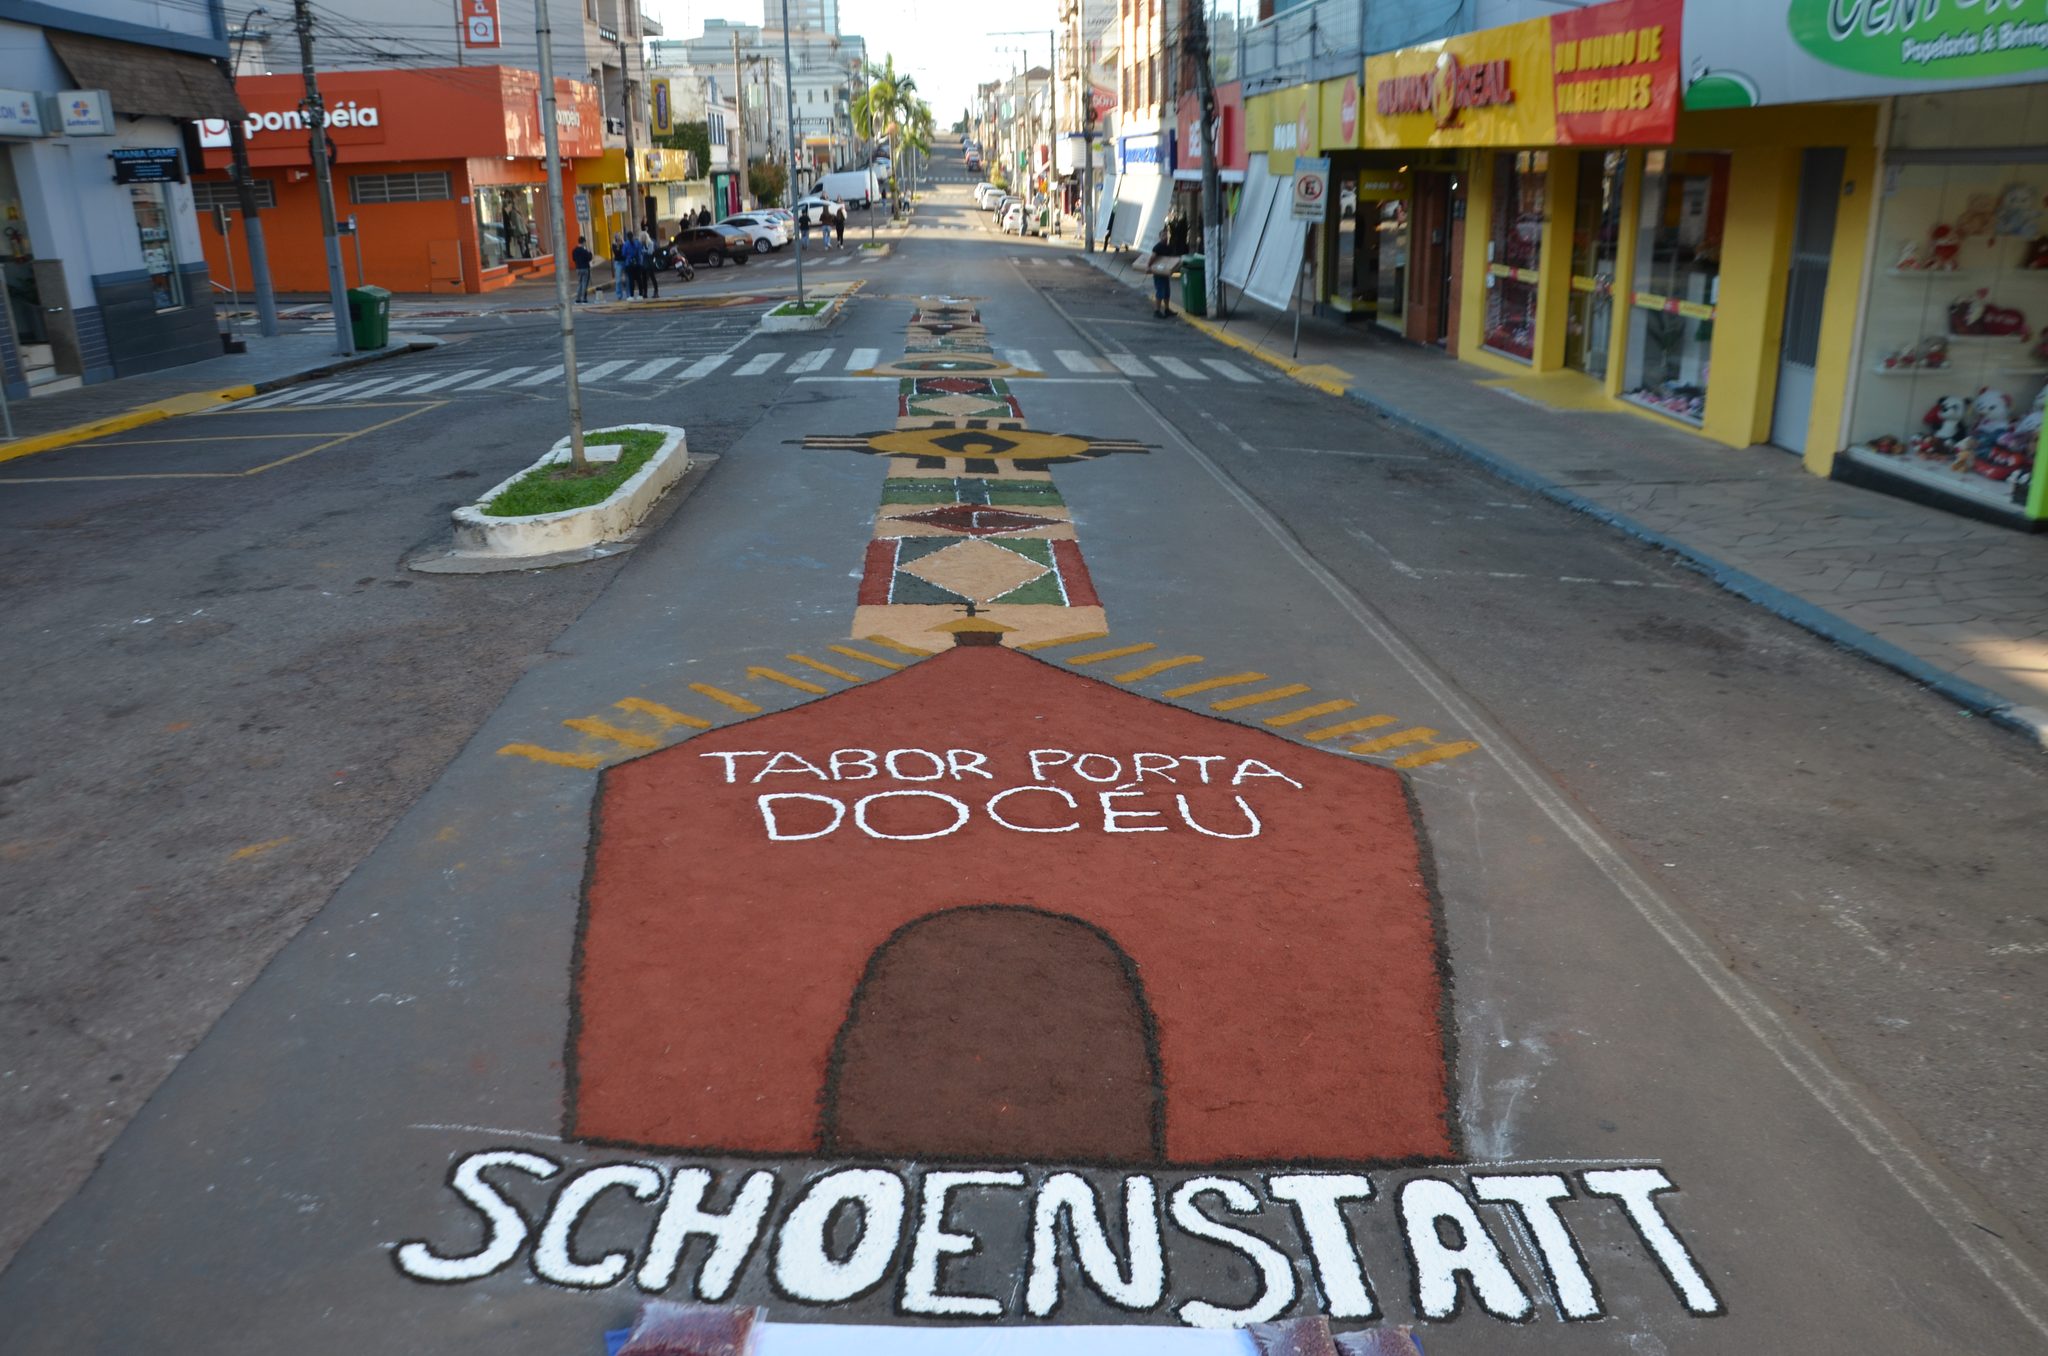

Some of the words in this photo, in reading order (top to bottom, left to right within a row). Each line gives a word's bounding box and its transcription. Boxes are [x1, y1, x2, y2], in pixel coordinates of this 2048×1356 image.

[1638, 25, 1663, 63] DE
[1456, 60, 1514, 108] REAL
[1557, 73, 1652, 114] VARIEDADES
[700, 748, 993, 784] TABOR
[1028, 748, 1303, 789] PORTA
[396, 1150, 1724, 1327] SCHOENSTATT
